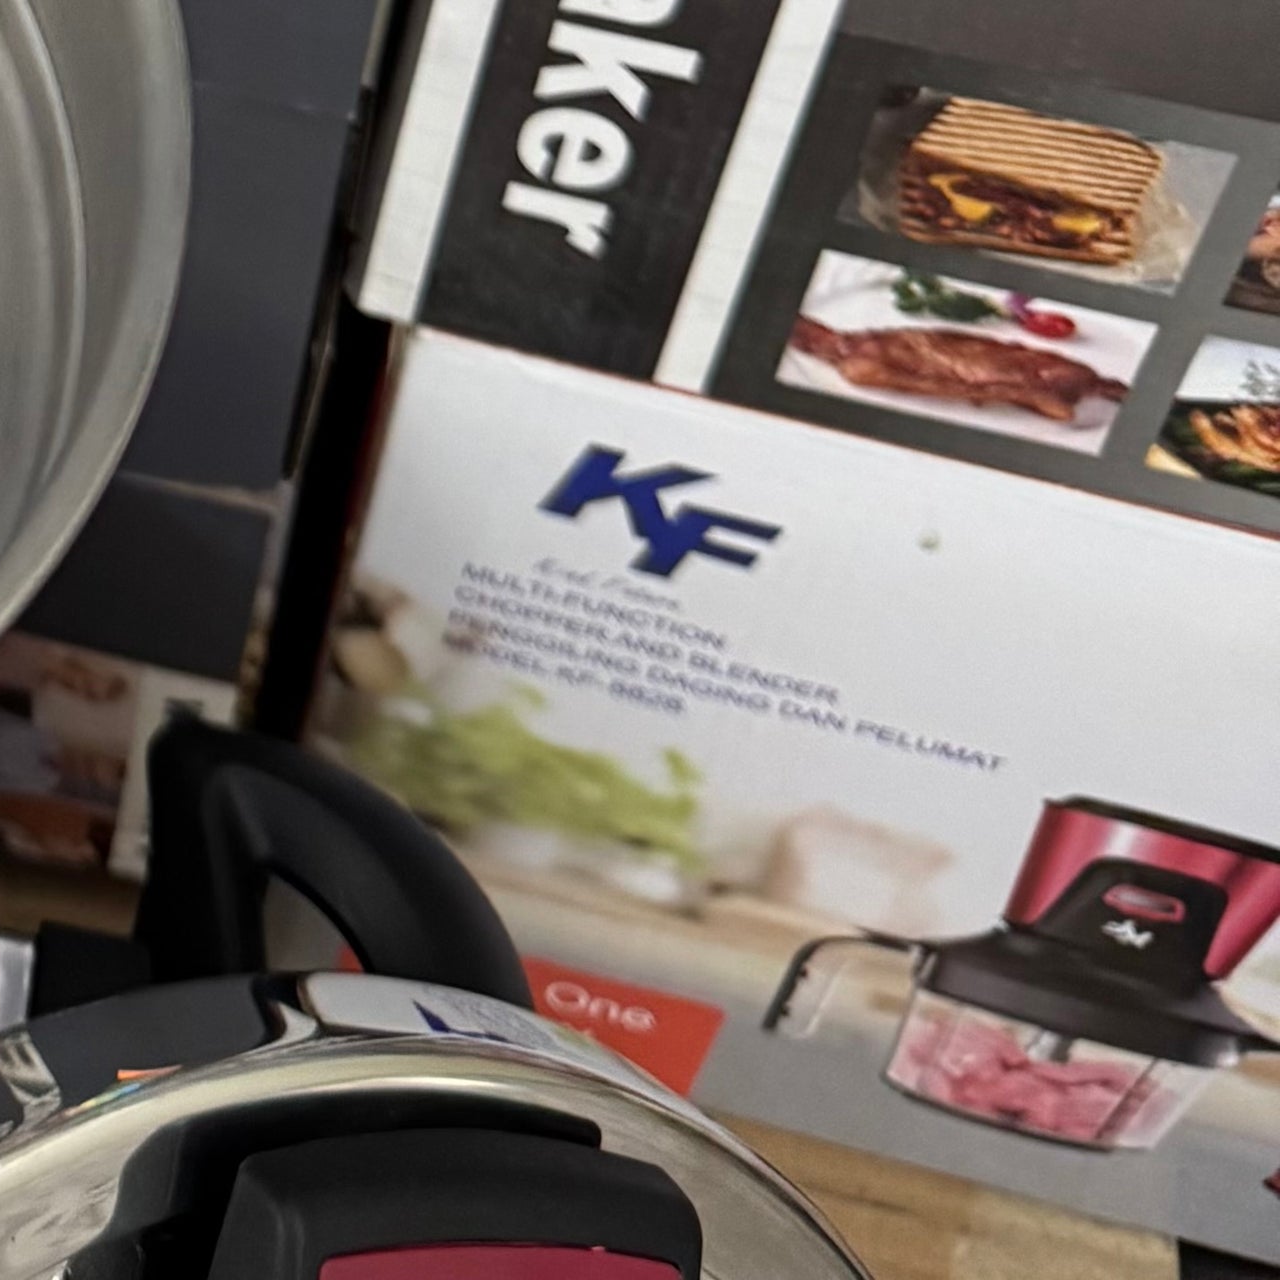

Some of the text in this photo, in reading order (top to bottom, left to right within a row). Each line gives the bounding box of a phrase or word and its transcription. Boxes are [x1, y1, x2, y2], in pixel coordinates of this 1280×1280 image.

[536, 441, 784, 579] KF
[614, 627, 686, 665] AND
[685, 647, 839, 708] BLENDER
[776, 698, 848, 735] DAN
[852, 716, 1005, 776] PELUMAT
[544, 980, 658, 1034] One
